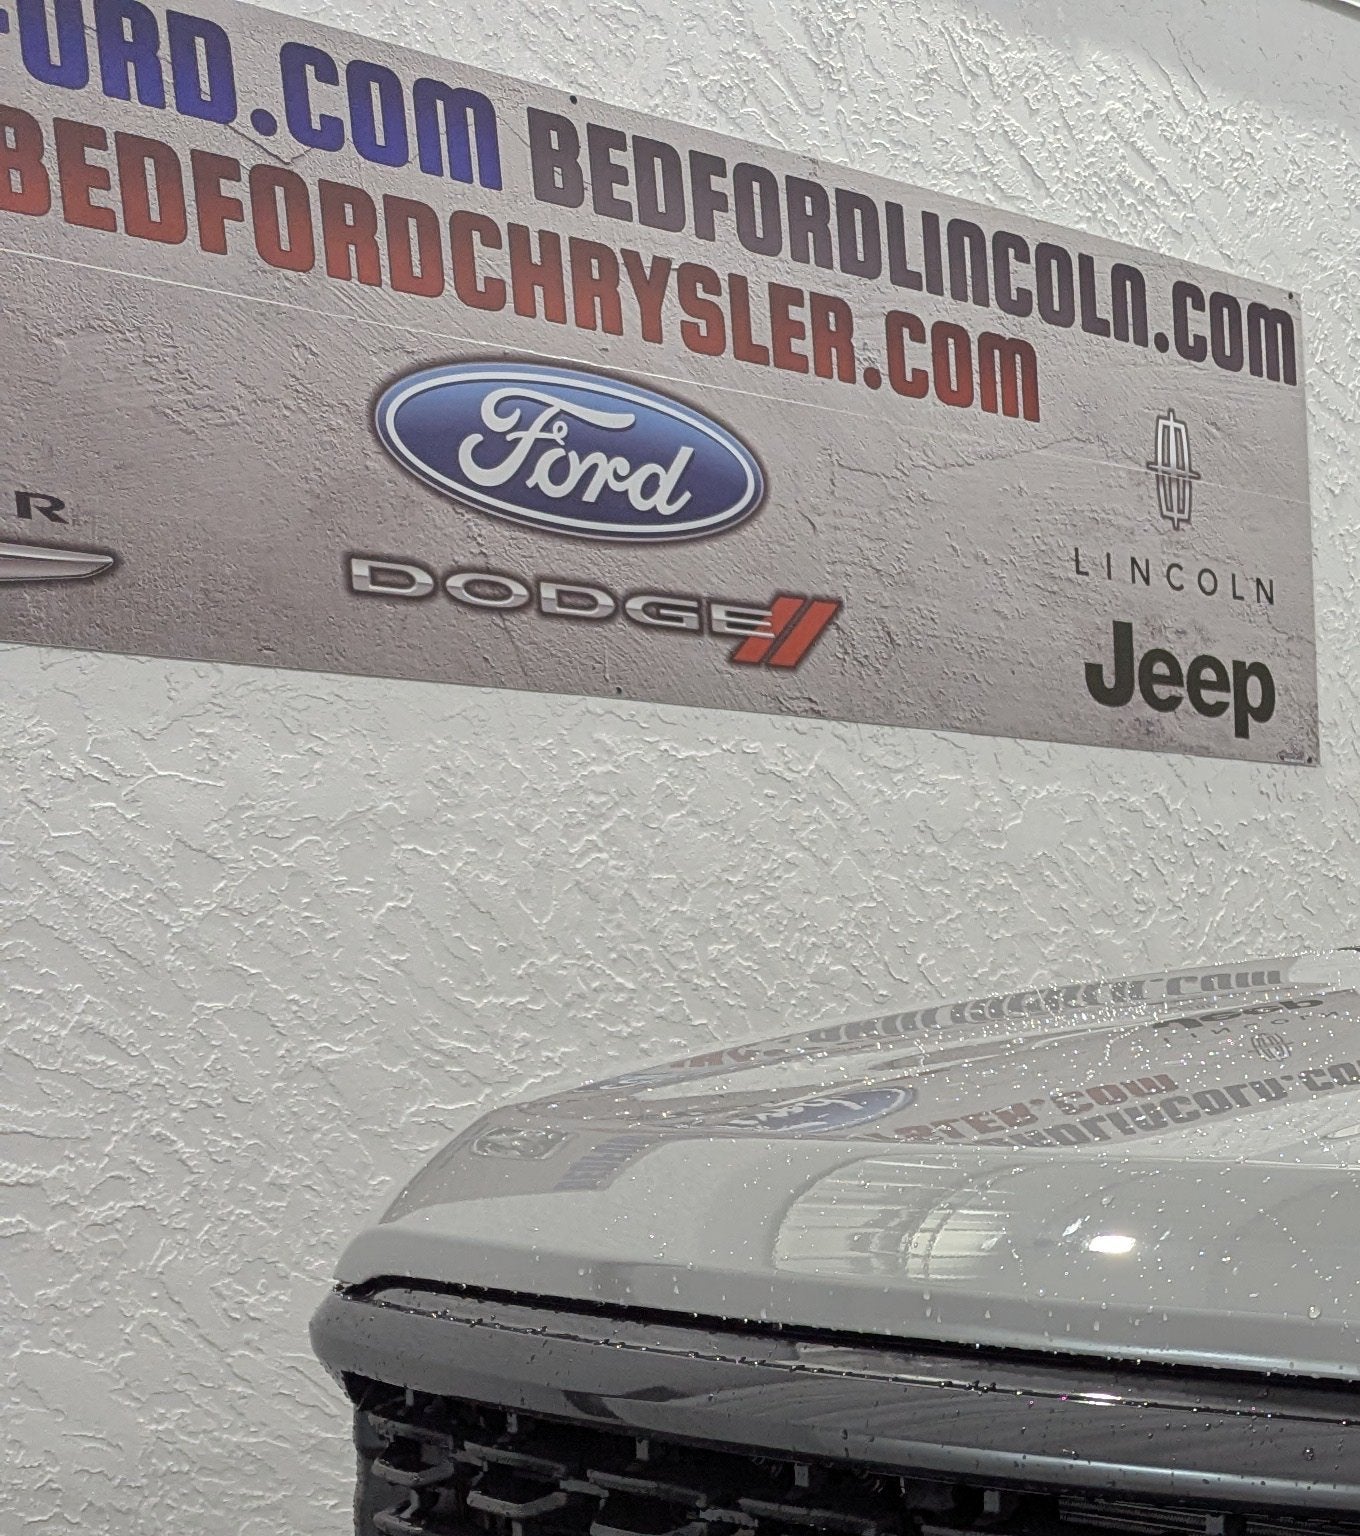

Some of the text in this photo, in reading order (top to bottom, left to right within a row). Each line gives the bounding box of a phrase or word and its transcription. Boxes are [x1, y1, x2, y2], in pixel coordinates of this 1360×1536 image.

[0, 0, 1298, 386] ORD.COM BEDFORDLINCOLN.COM
[0, 103, 1041, 422] BEDFORDCHRYSLER.COM
[458, 387, 694, 517] Ford
[350, 555, 776, 641] DODGE
[1073, 547, 1276, 606] LINCOLN
[1084, 620, 1276, 738] Jeep
